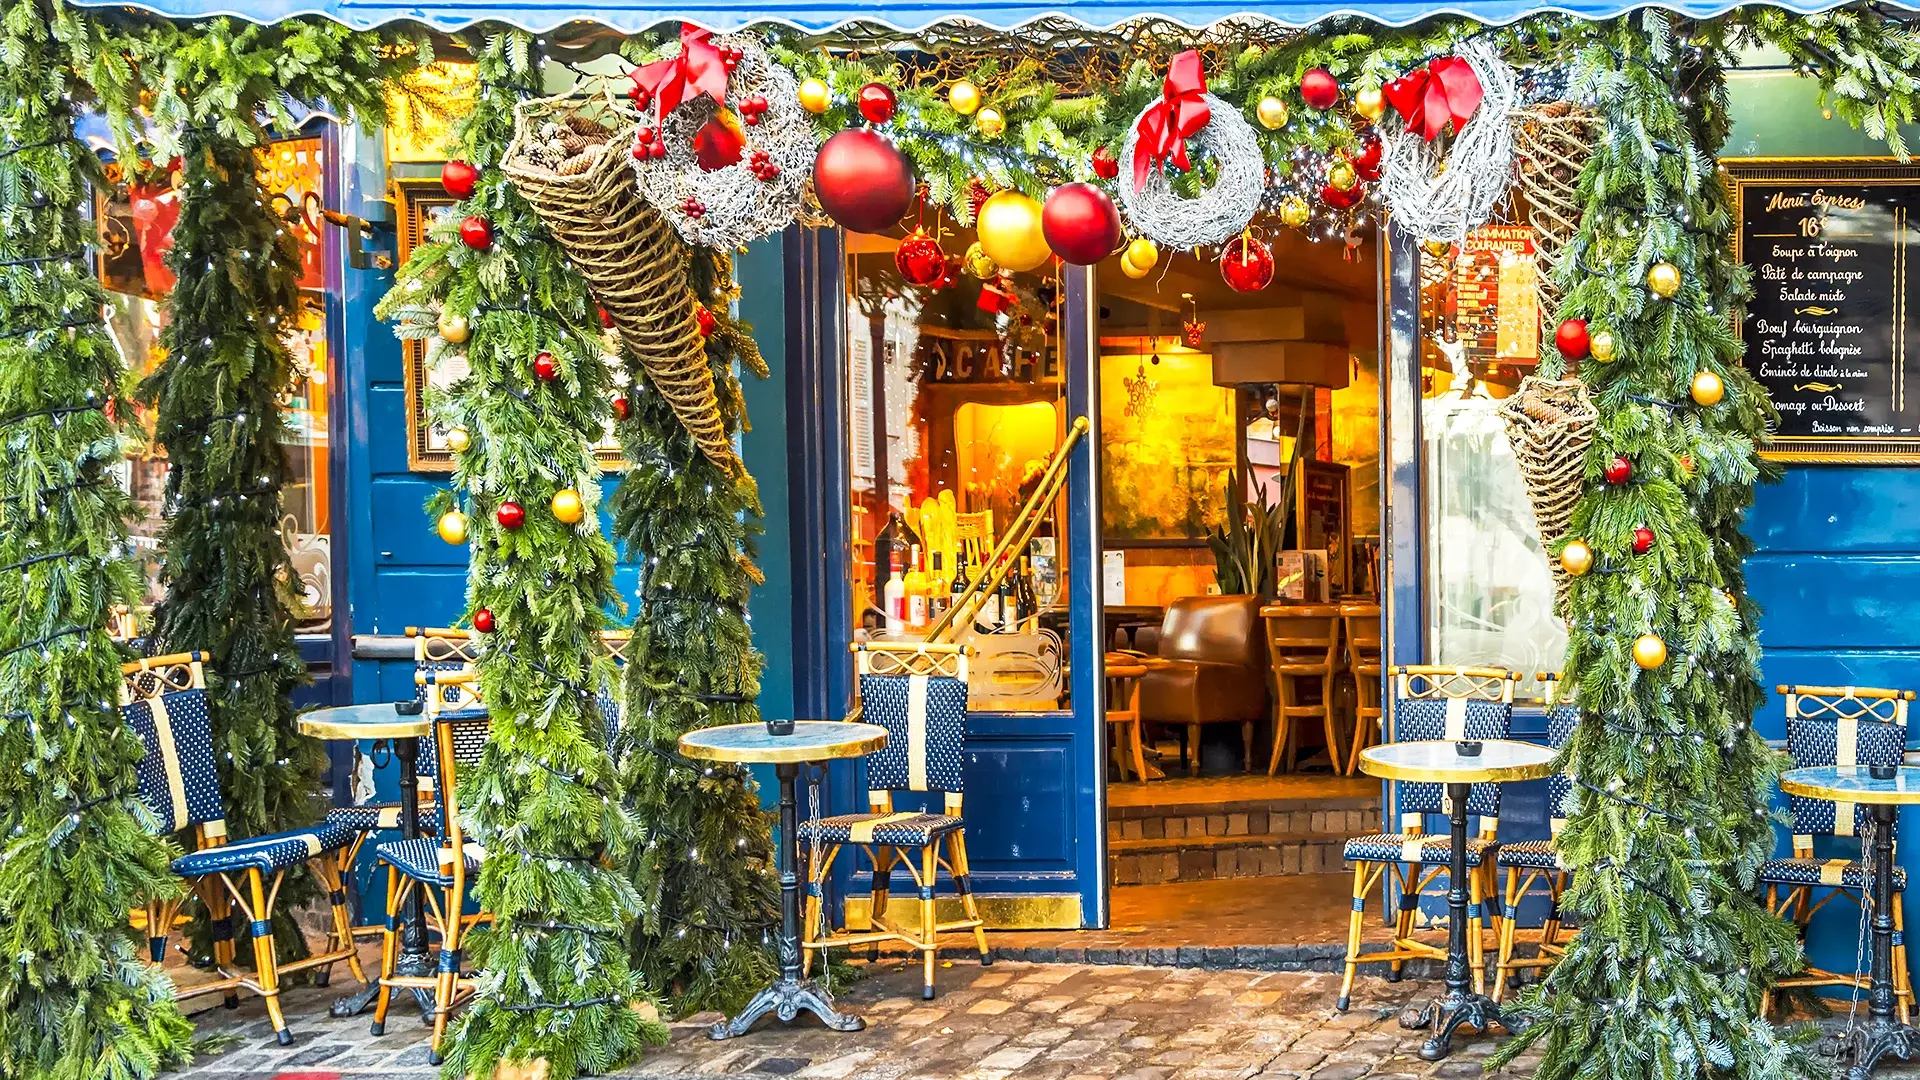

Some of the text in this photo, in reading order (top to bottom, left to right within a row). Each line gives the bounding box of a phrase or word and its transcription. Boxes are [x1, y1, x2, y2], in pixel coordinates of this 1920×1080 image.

[1766, 189, 1865, 213] Menu Express
[1466, 240, 1524, 251] COURANTES
[1772, 245, 1804, 262] Soupe
[1791, 267, 1804, 279] de
[1807, 271, 1864, 284] campagne
[1780, 287, 1846, 301] Salade mixte
[1762, 340, 1815, 360] Spaghetti
[1800, 364, 1812, 377] de
[1814, 364, 1839, 377] dinde
[1812, 403, 1822, 411] ou
[1823, 395, 1865, 411] Dessert
[1812, 420, 1894, 436] Boisson non comprise
